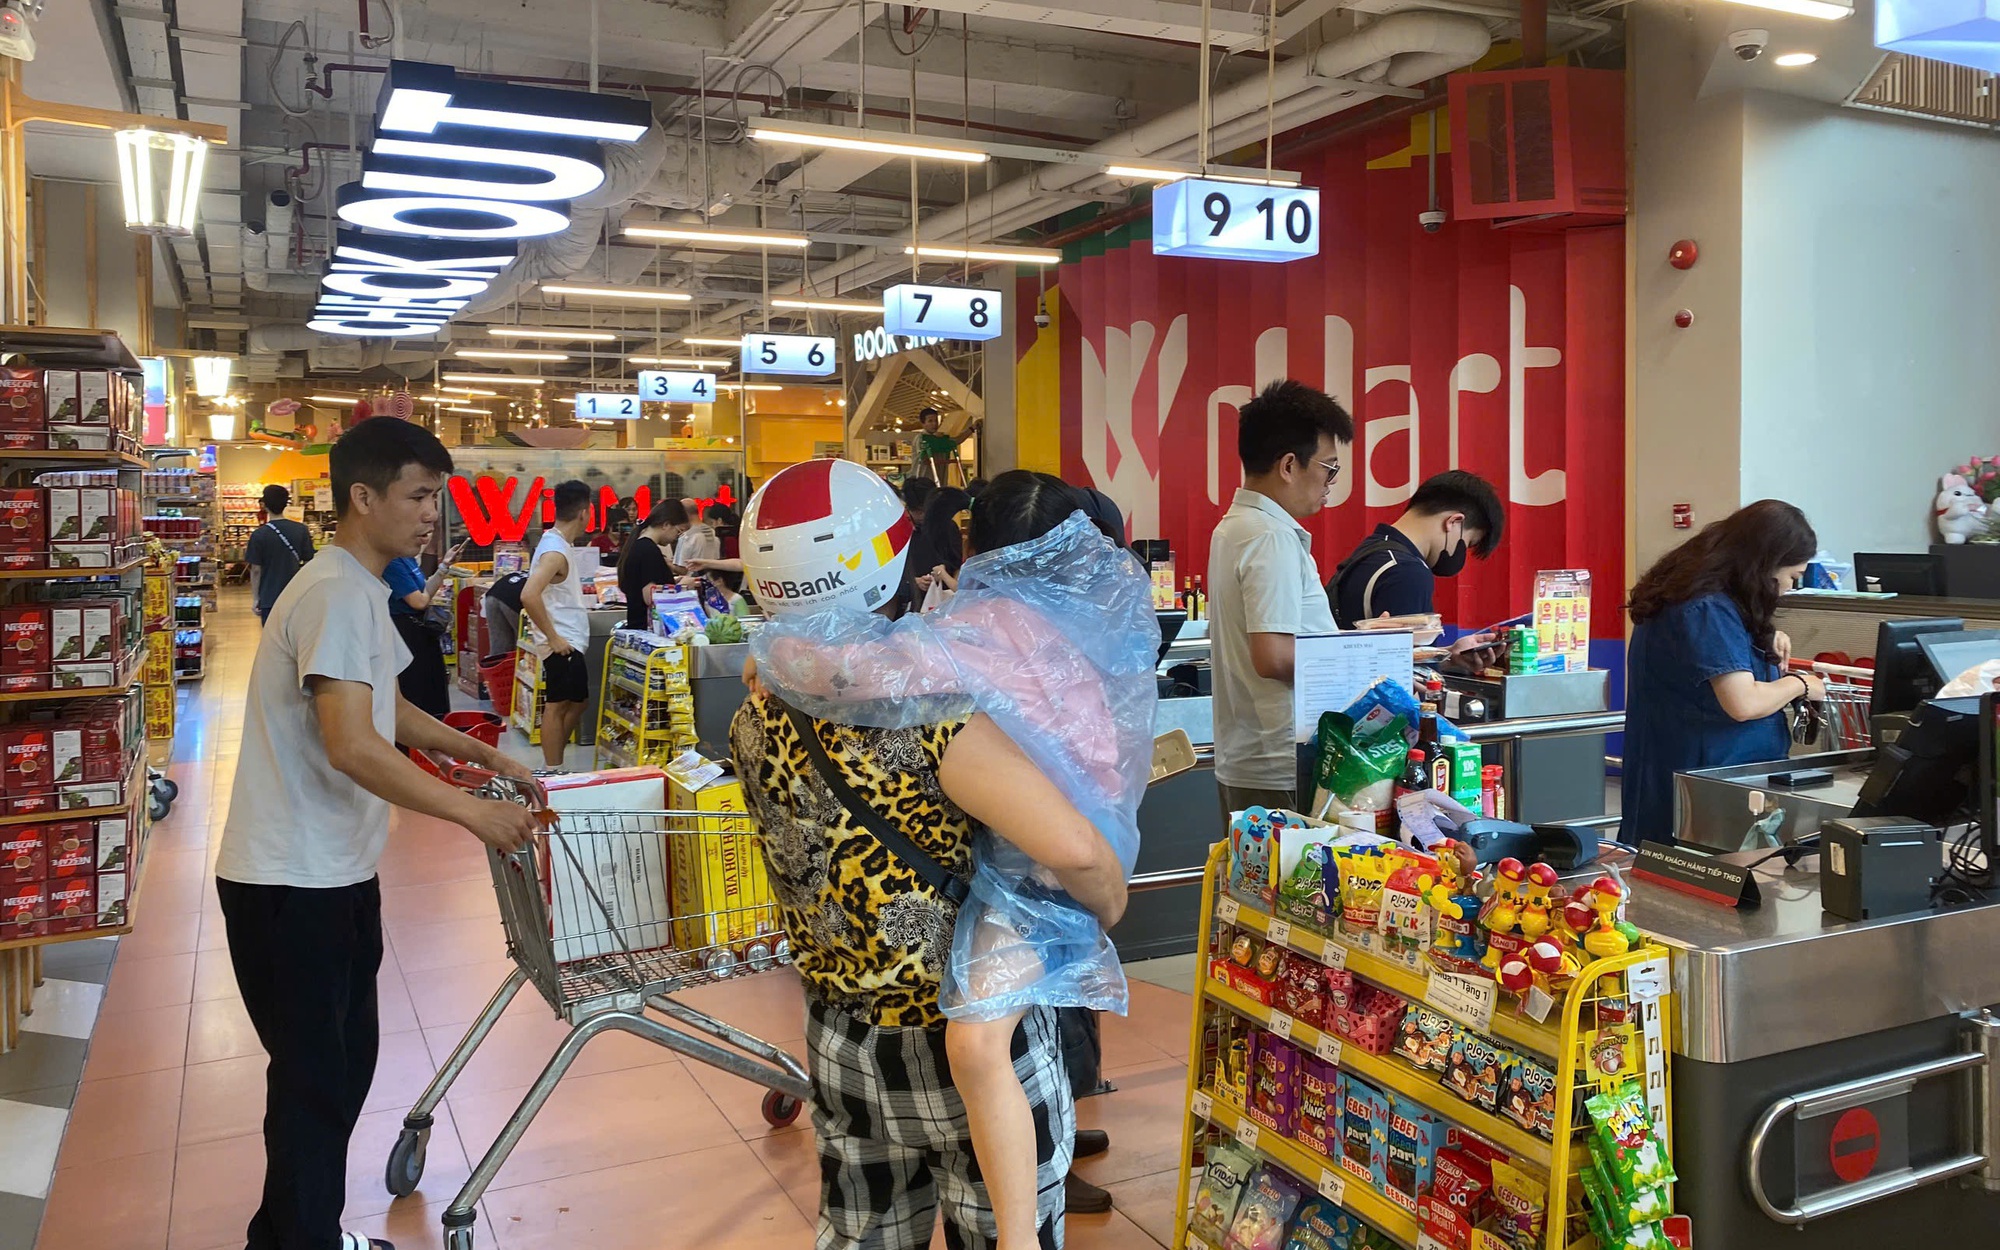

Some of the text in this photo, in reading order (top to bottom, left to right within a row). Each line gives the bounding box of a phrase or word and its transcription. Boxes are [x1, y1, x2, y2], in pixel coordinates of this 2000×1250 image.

[1203, 193, 1312, 244] 9 10
[913, 293, 989, 328] 7 8
[761, 341, 825, 367] 5 6
[854, 326, 898, 362] BOOK
[654, 376, 707, 397] 3 4
[587, 397, 633, 415] 1 2
[756, 570, 846, 599] HDBank
[1640, 849, 1651, 857] XIN
[1651, 852, 1664, 860] MỜI
[1664, 855, 1687, 867] KHÁCH
[1687, 861, 1706, 873] HÀNG
[1707, 867, 1723, 877] TIẾP
[1723, 872, 1742, 884] THEO
[726, 874, 738, 897] BIA
[1226, 905, 1234, 913] 37
[1276, 927, 1285, 936] 33
[1332, 952, 1341, 962] 33
[1453, 977, 1459, 986] 1
[1461, 979, 1481, 999] Tặng
[1482, 991, 1488, 1001] 1
[1464, 1004, 1479, 1018] 113
[1279, 1020, 1287, 1030] 12
[1327, 1045, 1336, 1055] 12
[1250, 1107, 1278, 1131] BEBETO
[1245, 1129, 1253, 1138] 27
[1298, 1129, 1328, 1156] BEBETO
[1213, 1166, 1235, 1185] VIDAL
[1341, 1157, 1373, 1183] BEBETO
[1329, 1181, 1339, 1191] 29
[1385, 1185, 1417, 1214] BEBETO
[1497, 1185, 1530, 1211] BEBETO
[1431, 1201, 1456, 1221] BEBETO
